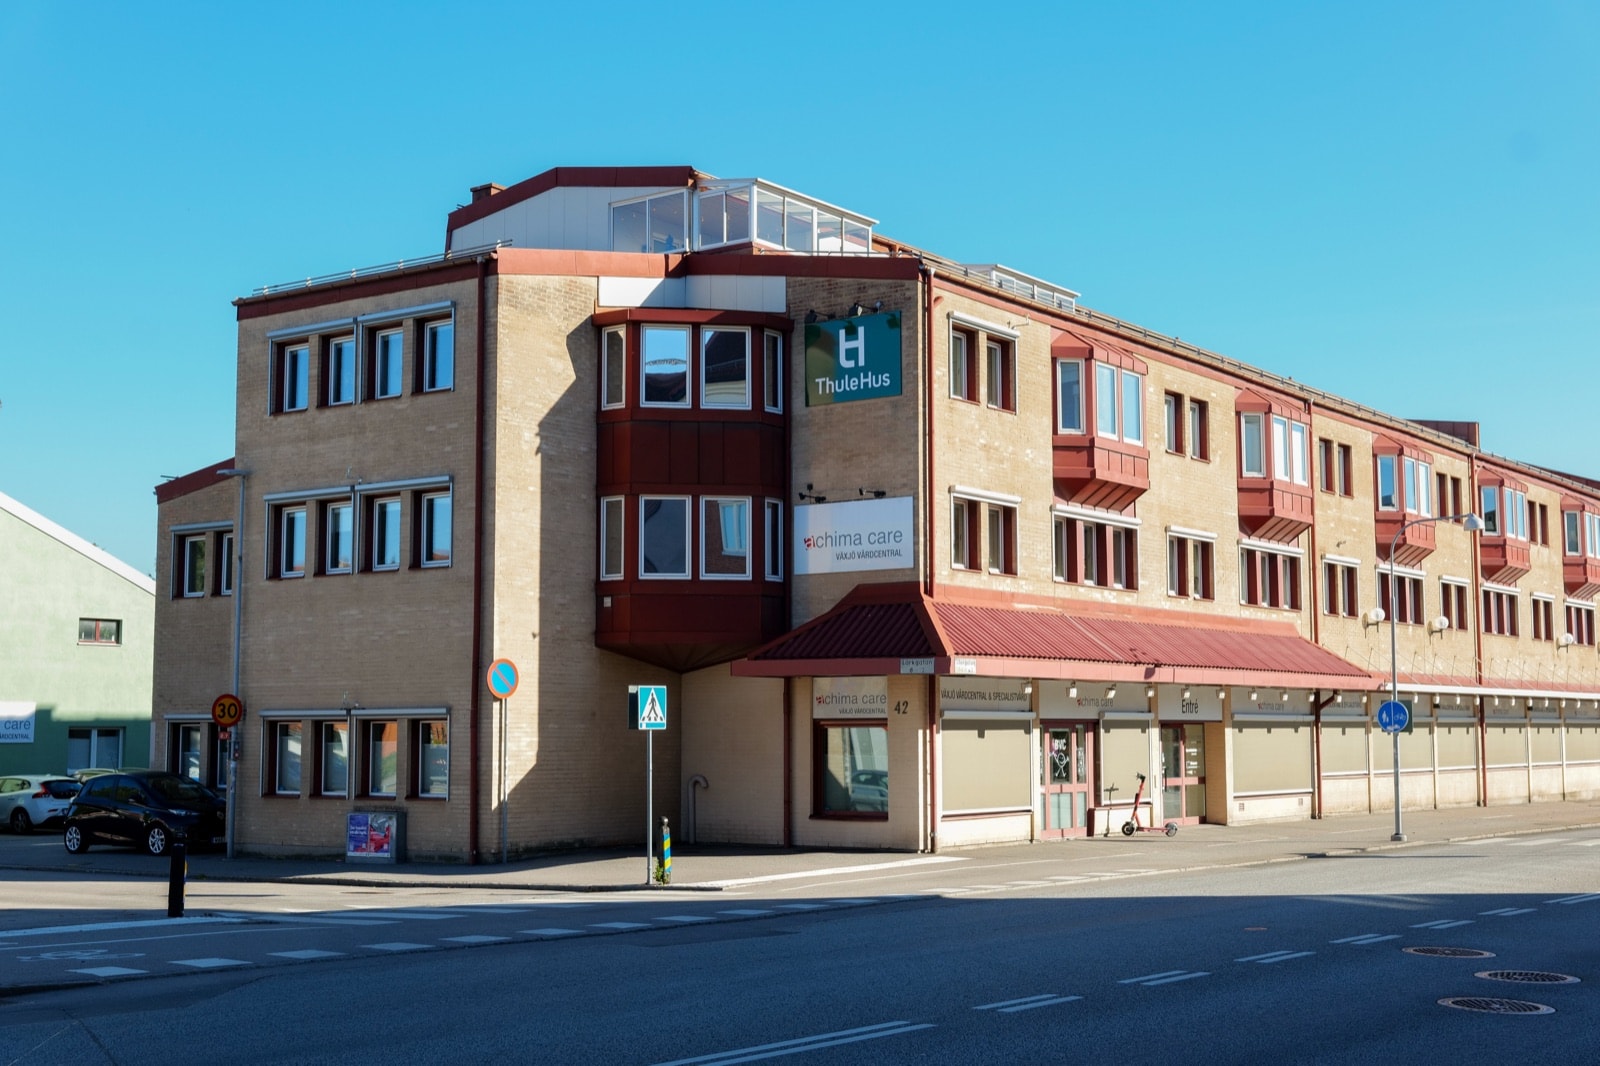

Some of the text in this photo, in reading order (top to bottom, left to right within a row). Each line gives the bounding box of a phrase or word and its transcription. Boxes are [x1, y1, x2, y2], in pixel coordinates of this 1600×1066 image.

[815, 371, 891, 395] ThuleHus
[868, 529, 903, 545] care
[857, 548, 903, 559] VÅRDCENTRAL
[862, 694, 887, 705] care
[1101, 698, 1114, 708] care
[1181, 699, 1199, 714] Entré
[217, 703, 238, 719] 30
[894, 701, 909, 715] 42
[4, 720, 31, 730] care
